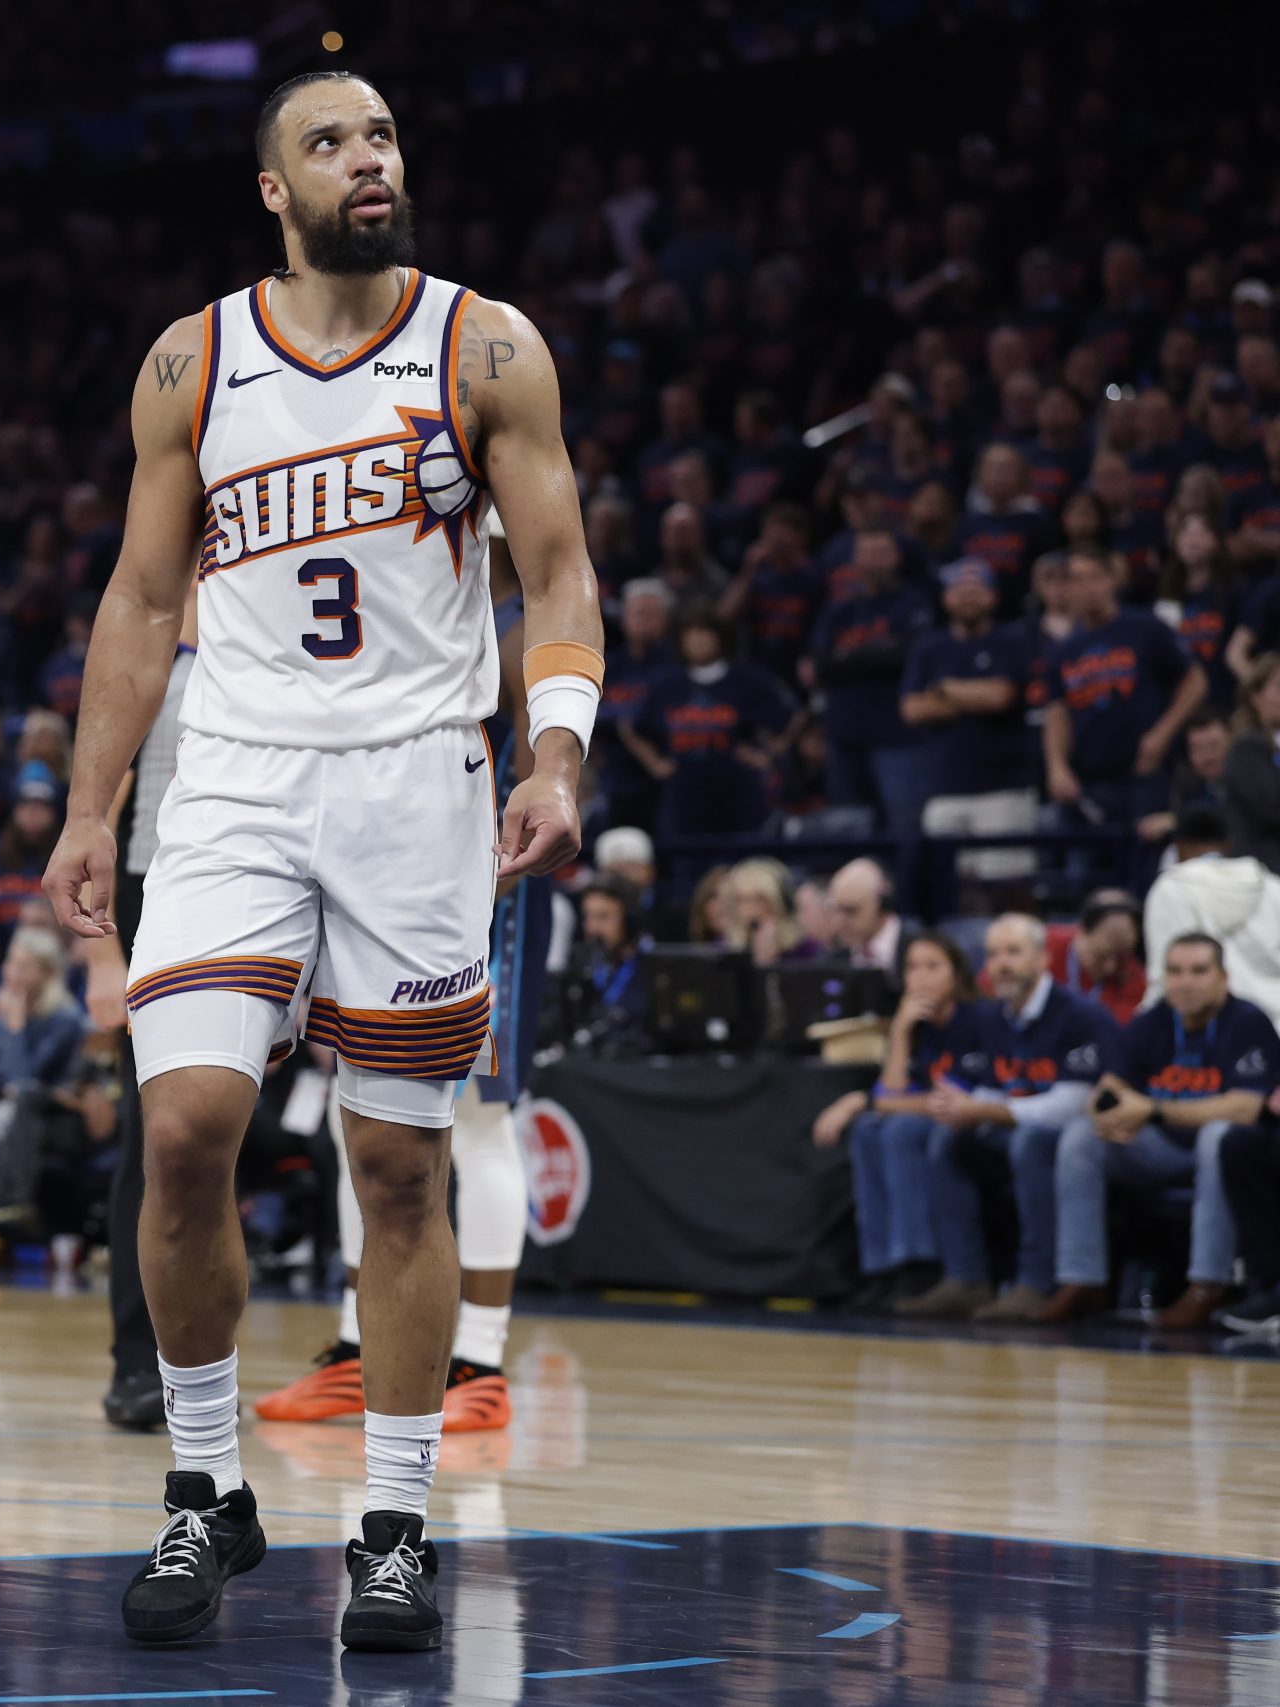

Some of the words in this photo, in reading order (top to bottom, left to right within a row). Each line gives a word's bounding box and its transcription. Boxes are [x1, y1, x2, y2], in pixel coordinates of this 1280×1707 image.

[153, 353, 195, 392] W
[373, 361, 433, 380] PayPal
[481, 339, 515, 379] P
[209, 443, 407, 567] SUNS
[297, 557, 364, 661] 3
[389, 955, 485, 1004] PHOENIX
